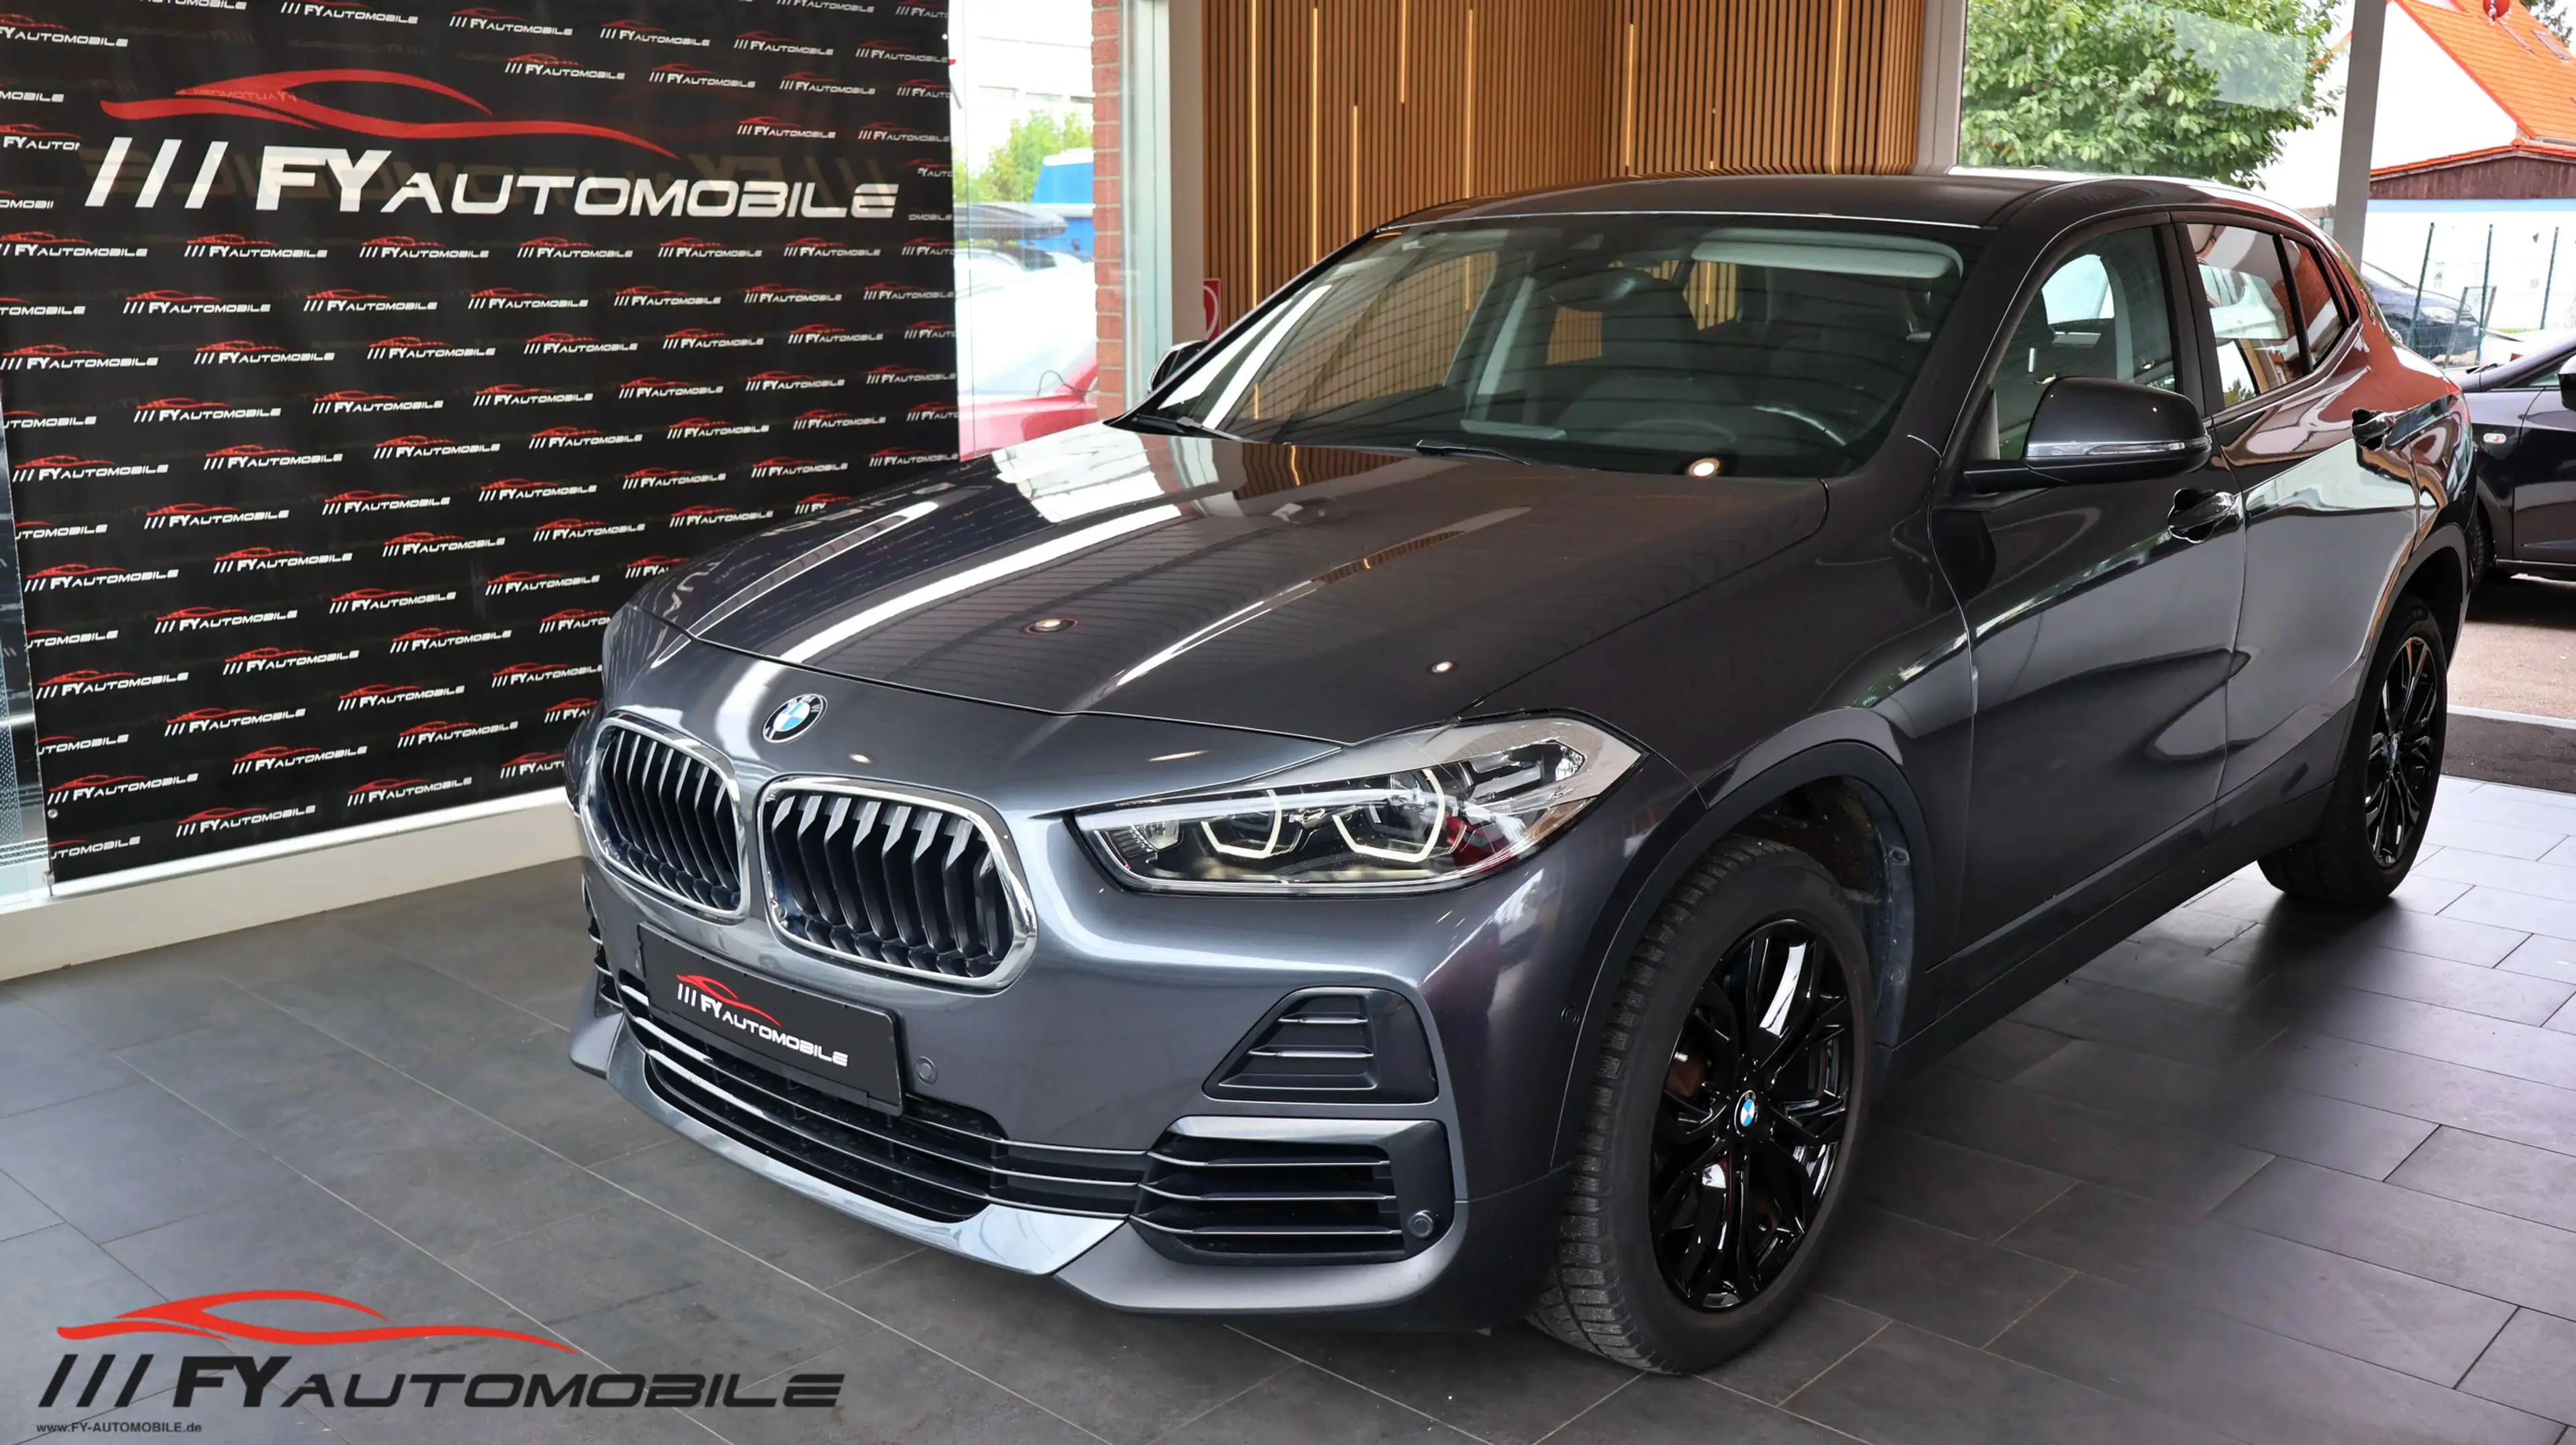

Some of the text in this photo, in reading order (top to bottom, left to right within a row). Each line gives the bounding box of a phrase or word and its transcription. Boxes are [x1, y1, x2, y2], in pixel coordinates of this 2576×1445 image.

[304, 5, 418, 24] FYAUTOMOBILE
[470, 18, 573, 36] FYAUTOMOBILE
[619, 30, 710, 46] FYAUTOMOBILE
[750, 41, 834, 55] FYAUTOMOBILE
[525, 64, 625, 80] FYAUTOMOBILE
[667, 73, 755, 88] FYAUTOMOBILE
[796, 81, 875, 95] FYAUTOMOBILE
[754, 126, 836, 138] FYAUTOMOBILE
[256, 146, 899, 219] FYAUTOMOBILE
[209, 246, 327, 258] FYAUTOMOBILE
[381, 247, 489, 258] FYAUTOMOBILE
[537, 248, 633, 258] FYAUTOMOBILE
[676, 247, 762, 257] FYAUTOMOBILE
[800, 247, 881, 256] FYAUTOMOBILE
[327, 300, 437, 311] FYAUTOMOBILE
[488, 298, 588, 309] FYAUTOMOBILE
[631, 295, 721, 306] FYAUTOMOBILE
[759, 293, 842, 303] FYAUTOMOBILE
[148, 302, 271, 313] FYAUTOMOBILE
[681, 338, 764, 348] FYAUTOMOBILE
[805, 333, 883, 343] FYAUTOMOBILE
[388, 347, 496, 359] FYAUTOMOBILE
[543, 343, 638, 354] FYAUTOMOBILE
[27, 357, 158, 370] FYAUTOMOBILE
[218, 352, 335, 364] FYAUTOMOBILE
[637, 386, 723, 398] FYAUTOMOBILE
[763, 379, 845, 390] FYAUTOMOBILE
[334, 400, 443, 413] FYAUTOMOBILE
[494, 393, 593, 405] FYAUTOMOBILE
[159, 408, 281, 421] FYAUTOMOBILE
[684, 425, 769, 437] FYAUTOMOBILE
[549, 434, 643, 447] FYAUTOMOBILE
[396, 443, 500, 458] FYAUTOMOBILE
[227, 453, 343, 469] FYAUTOMOBILE
[39, 464, 168, 481] FYAUTOMOBILE
[769, 463, 848, 476] FYAUTOMOBILE
[641, 473, 727, 488] FYAUTOMOBILE
[499, 485, 597, 500] FYAUTOMOBILE
[344, 497, 450, 513] FYAUTOMOBILE
[169, 510, 289, 527] FYAUTOMOBILE
[687, 511, 773, 526] FYAUTOMOBILE
[553, 523, 645, 540] FYAUTOMOBILE
[402, 537, 505, 555] FYAUTOMOBILE
[237, 553, 352, 572] FYAUTOMOBILE
[50, 569, 179, 590] FYAUTOMOBILE
[505, 575, 600, 593] FYAUTOMOBILE
[352, 592, 456, 611] FYAUTOMOBILE
[179, 610, 298, 631] FYAUTOMOBILE
[411, 630, 512, 651] FYAUTOMOBILE
[246, 650, 360, 672] FYAUTOMOBILE
[62, 672, 189, 696] FYAUTOMOBILE
[360, 686, 465, 708] FYAUTOMOBILE
[189, 708, 306, 733] FYAUTOMOBILE
[418, 721, 518, 745] FYAUTOMOBILE
[255, 746, 368, 771] FYAUTOMOBILE
[73, 773, 199, 801] FYAUTOMOBILE
[369, 777, 472, 802] FYAUTOMOBILE
[200, 805, 316, 833] FYAUTOMOBILE
[700, 994, 848, 1067] FYAUTOMOBILE
